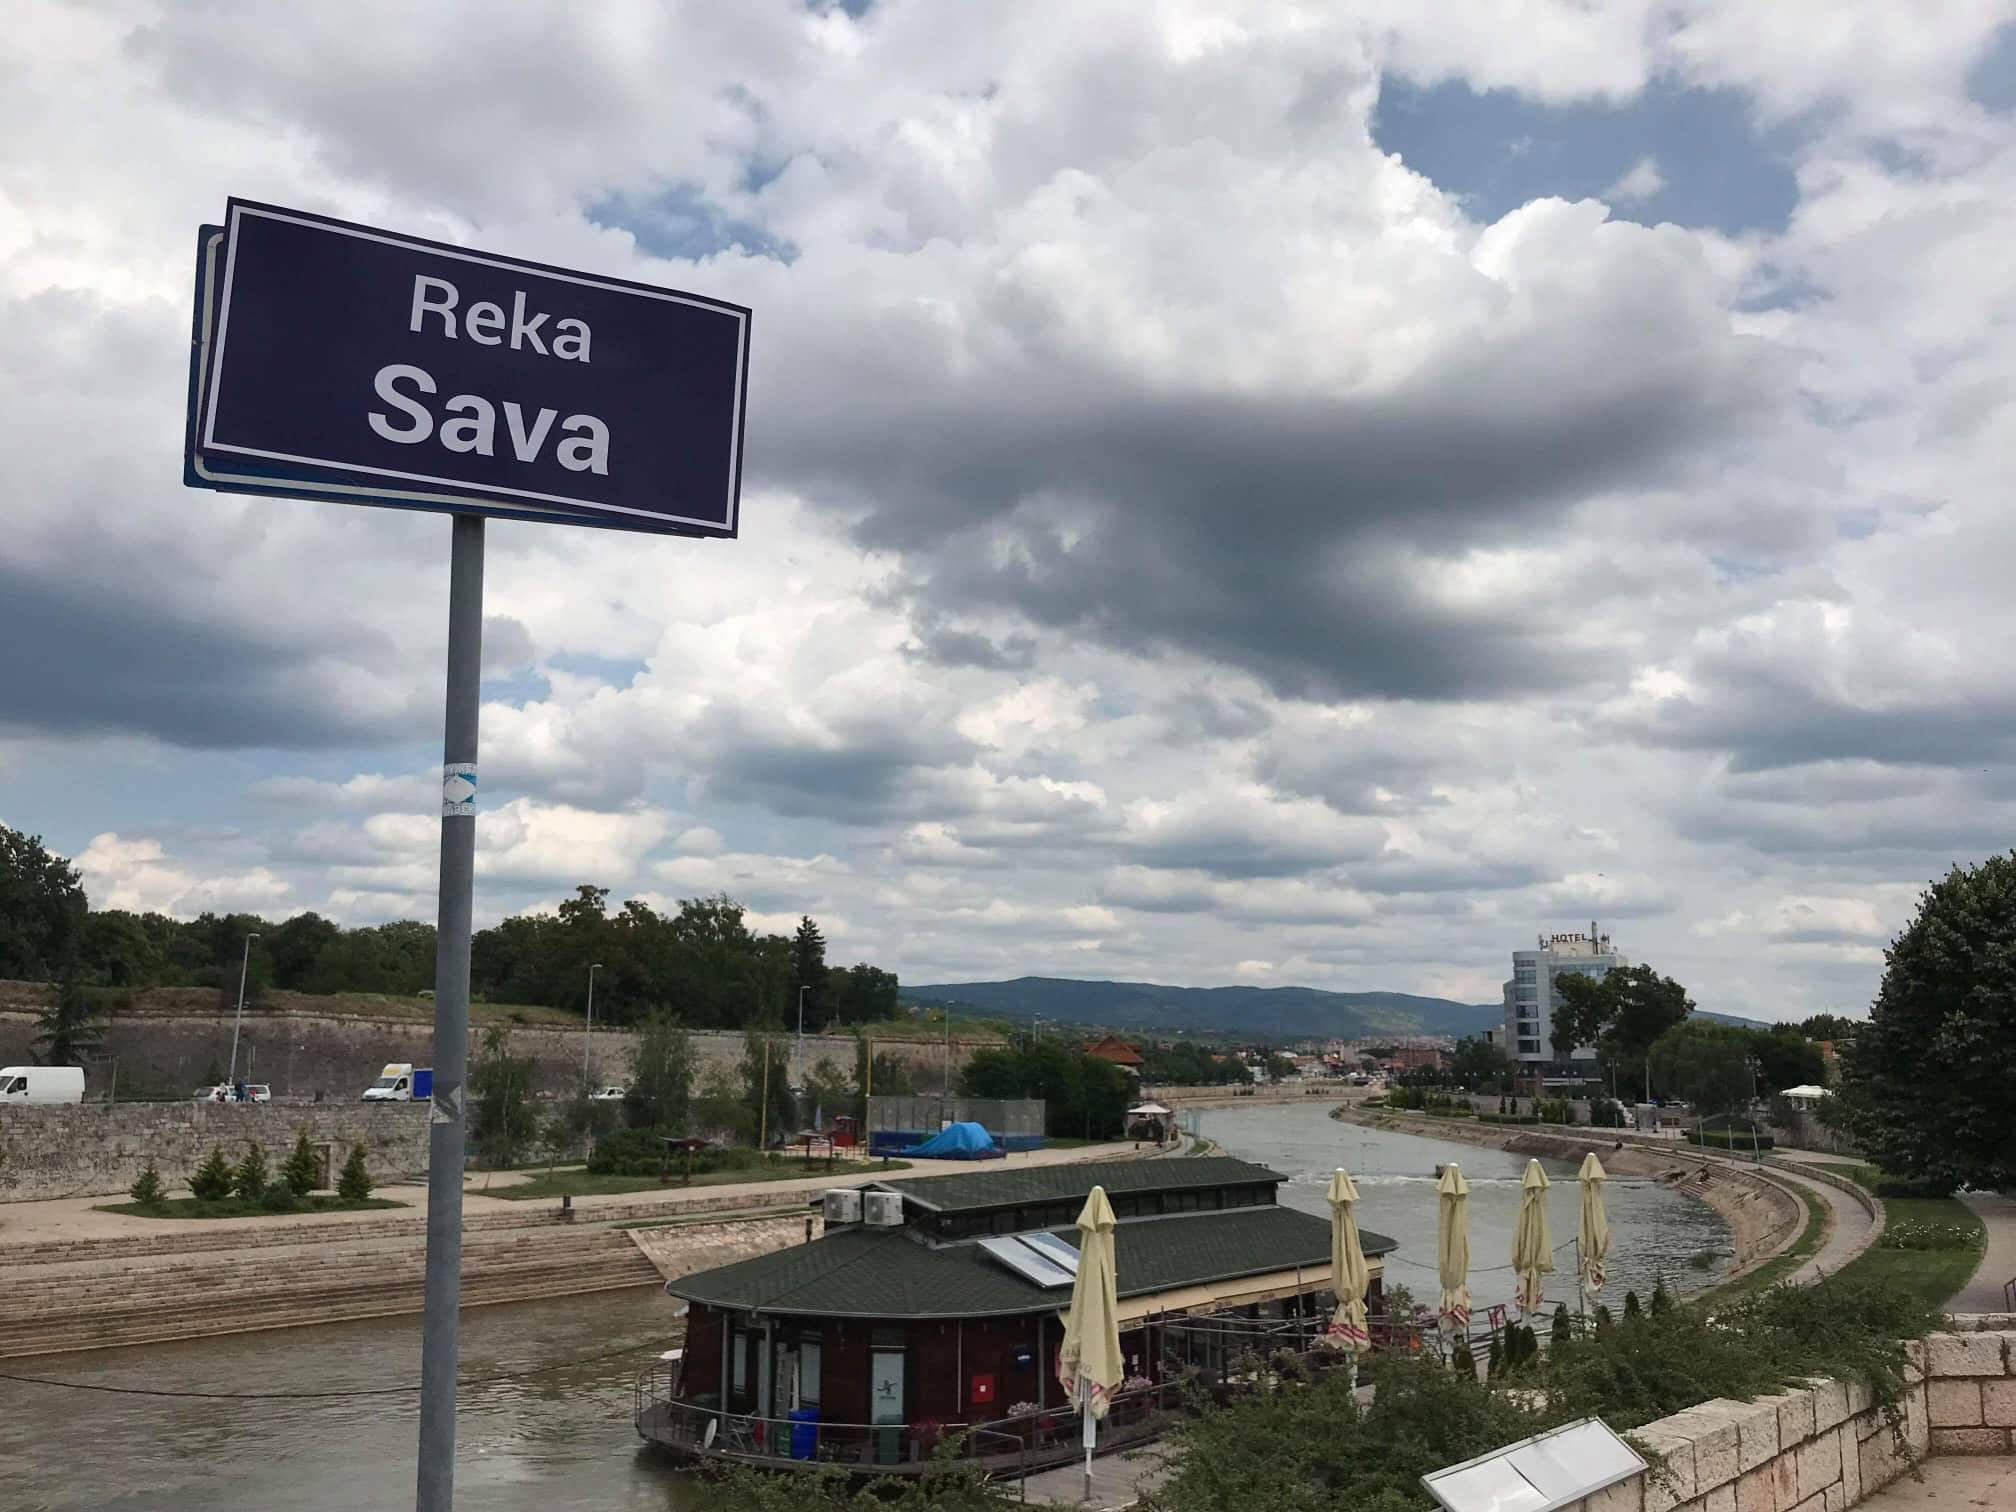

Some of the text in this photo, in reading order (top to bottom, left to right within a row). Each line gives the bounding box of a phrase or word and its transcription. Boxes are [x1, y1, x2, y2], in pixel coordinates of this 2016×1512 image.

[409, 274, 592, 364] Reka
[368, 364, 610, 476] Sava
[1551, 933, 1588, 943] HOTEL
